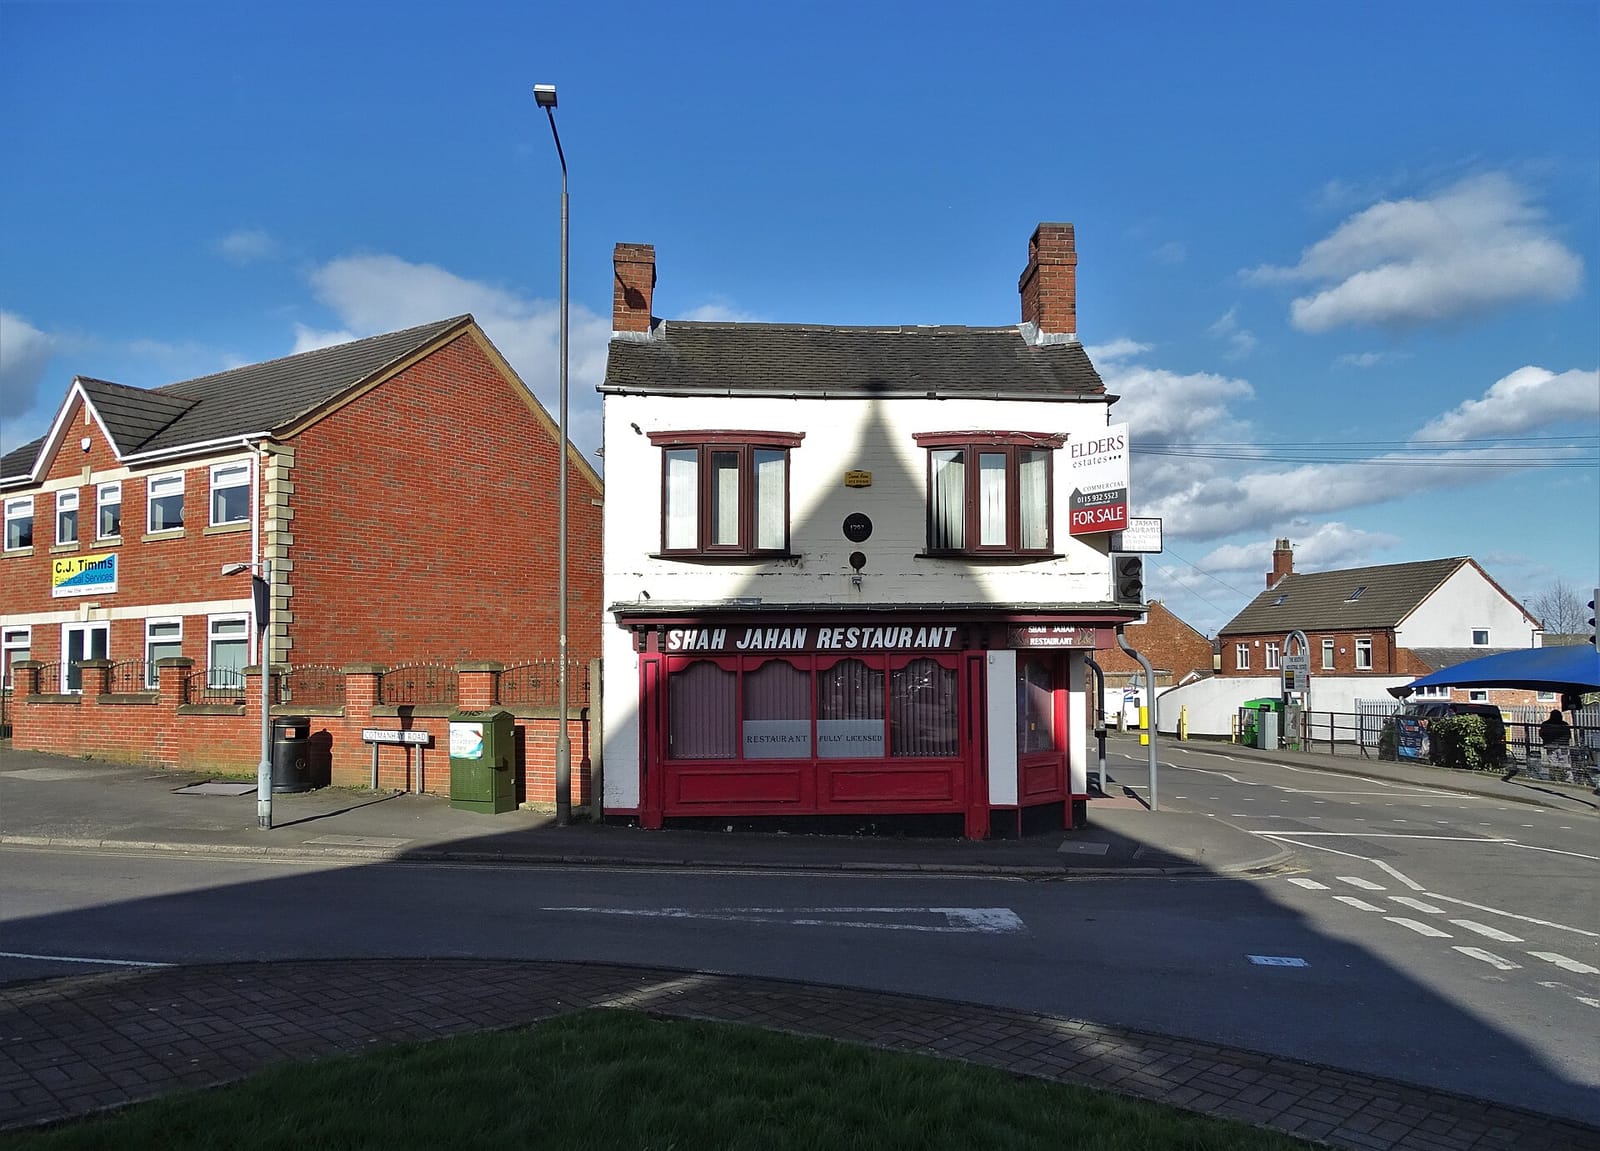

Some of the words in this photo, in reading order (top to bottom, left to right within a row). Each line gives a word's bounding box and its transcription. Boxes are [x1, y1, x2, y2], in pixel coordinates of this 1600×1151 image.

[1071, 435, 1124, 458] ELDERS
[1083, 481, 1124, 492] COMMERCIAL
[1077, 495, 1091, 504] 0115
[1092, 493, 1103, 502] 932
[1104, 492, 1118, 500] 5523
[1073, 511, 1095, 526] FOR
[1096, 506, 1124, 523] SALE
[56, 561, 74, 574] C.J.
[78, 559, 113, 571] Timms
[85, 573, 113, 584] Services
[668, 629, 726, 650] SHAH
[736, 628, 807, 649] JAHAN
[816, 627, 957, 649] RESTAURANT
[1029, 637, 1073, 646] RESTAURANT
[365, 731, 405, 741] COTMANHAY
[407, 732, 426, 741] ROAD
[746, 735, 808, 743] RESTAURANT
